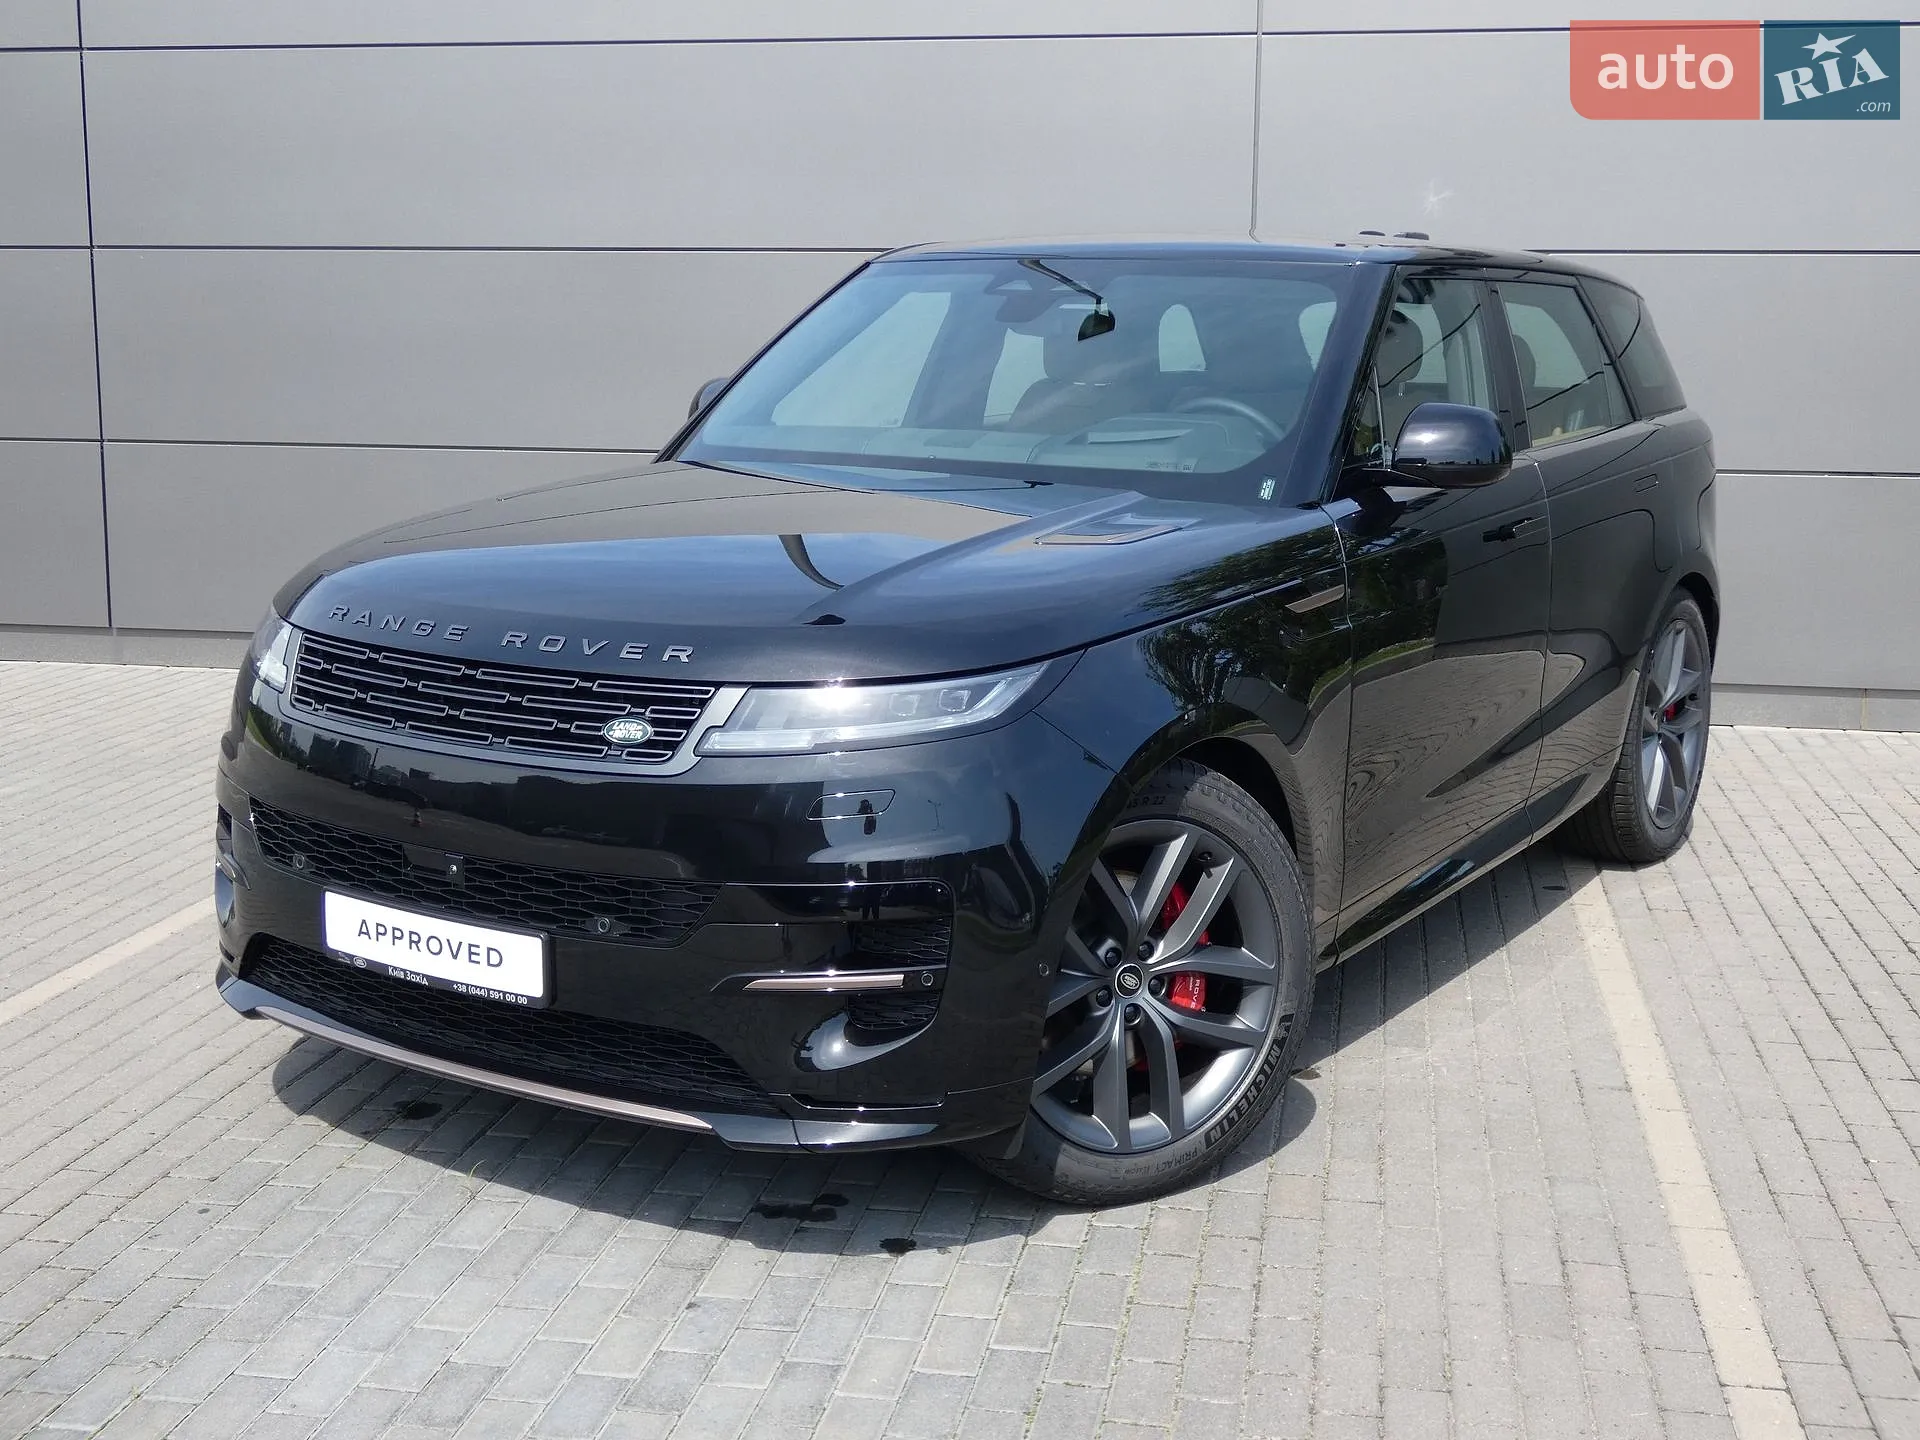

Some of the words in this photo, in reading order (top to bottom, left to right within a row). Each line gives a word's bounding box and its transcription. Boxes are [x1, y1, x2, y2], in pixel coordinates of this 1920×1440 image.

[328, 605, 471, 643] RANGE
[500, 631, 694, 663] ROVER
[612, 721, 638, 730] LAND
[613, 730, 643, 739] ROVER
[357, 919, 504, 968] APPROVED
[388, 966, 405, 979] Київ
[452, 983, 467, 993] +38
[468, 985, 488, 998] (044)
[489, 990, 504, 1000] 591
[505, 993, 516, 1003] 00
[517, 996, 528, 1005] 00
[1210, 1044, 1282, 1143] MICHELIN
